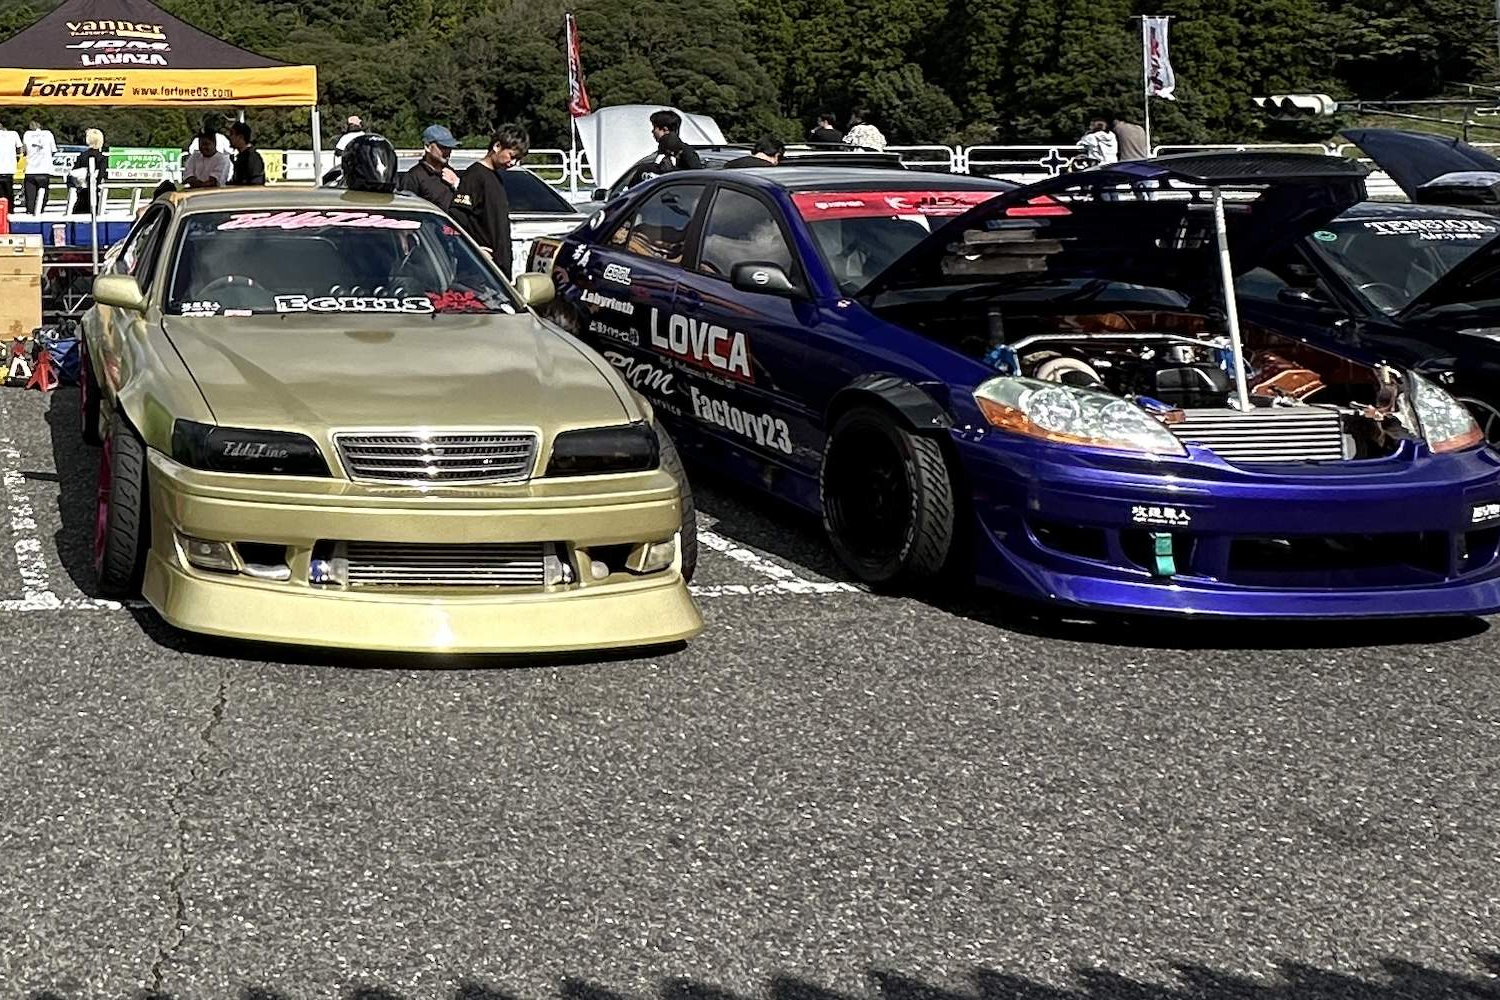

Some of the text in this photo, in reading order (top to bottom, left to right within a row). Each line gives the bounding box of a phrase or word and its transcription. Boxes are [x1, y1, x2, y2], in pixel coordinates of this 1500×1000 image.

[80, 53, 169, 66] LAVAZA
[22, 76, 126, 97] FORTUNE
[580, 288, 635, 315] Labyrinth
[650, 307, 751, 378] LOVCA
[690, 385, 793, 455] Factory23
